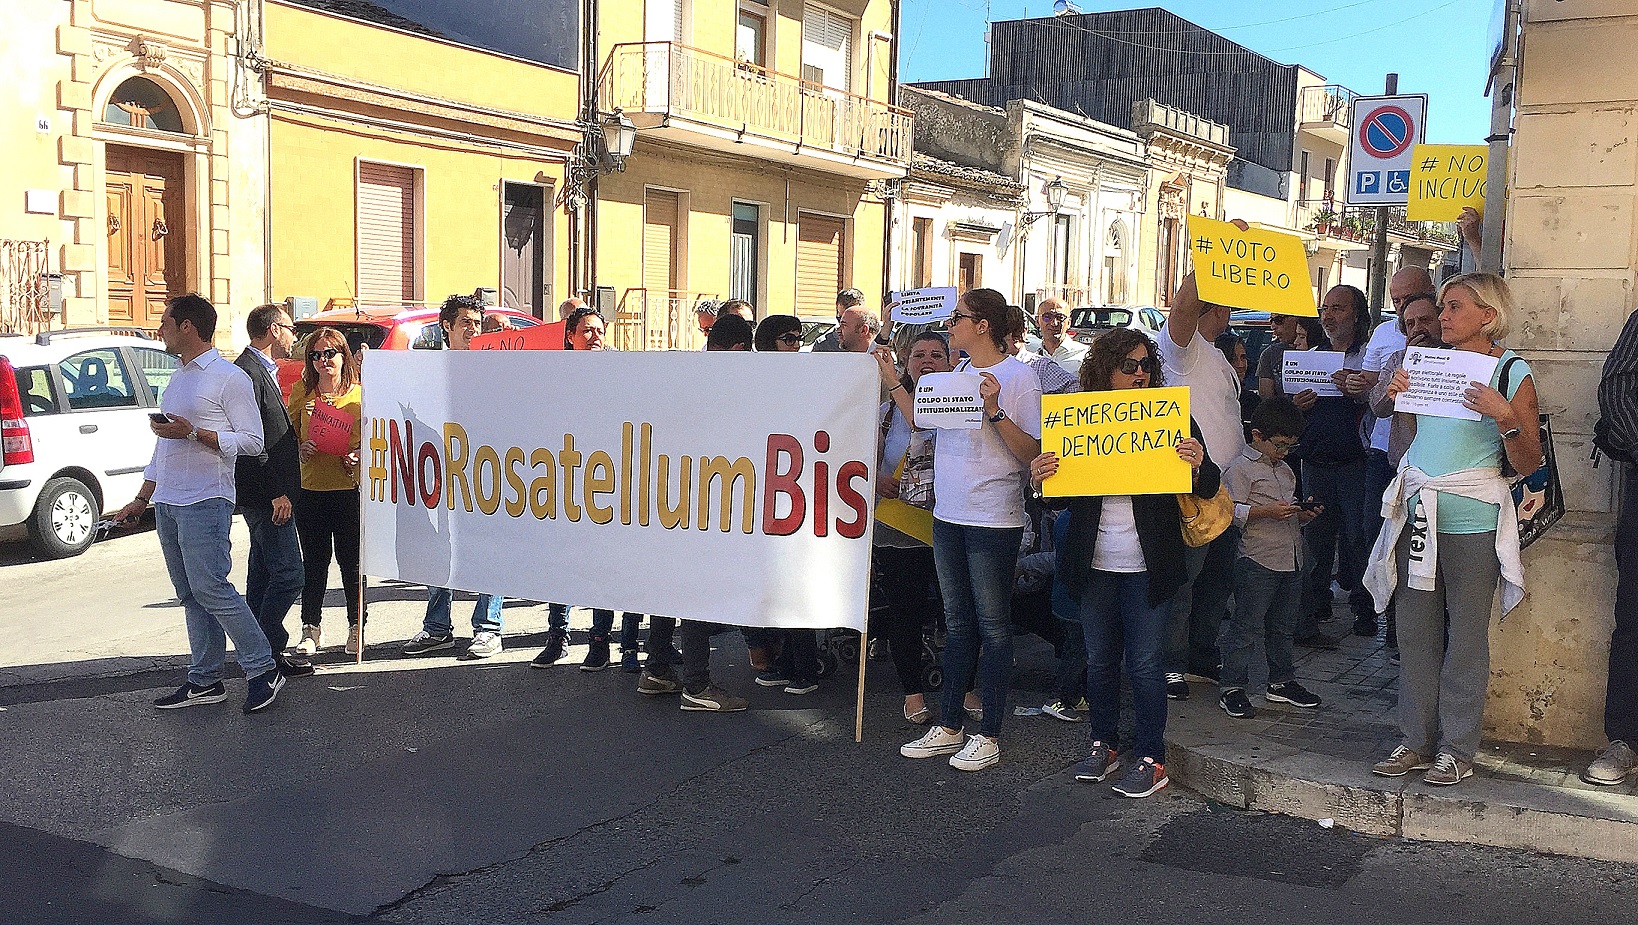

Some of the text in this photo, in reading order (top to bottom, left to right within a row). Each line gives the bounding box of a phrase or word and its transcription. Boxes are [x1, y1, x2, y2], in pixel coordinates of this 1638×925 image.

[1420, 154, 1484, 173] # NO
[1361, 173, 1376, 192] P
[1196, 235, 1276, 262] # VOTO
[1211, 261, 1290, 290] LIBERO
[917, 396, 941, 404] COLPO
[1043, 400, 1182, 429] #EMERGENZA
[1062, 429, 1185, 458] DEMOCRAZIA
[368, 416, 870, 540] #NoRosatellumBis
